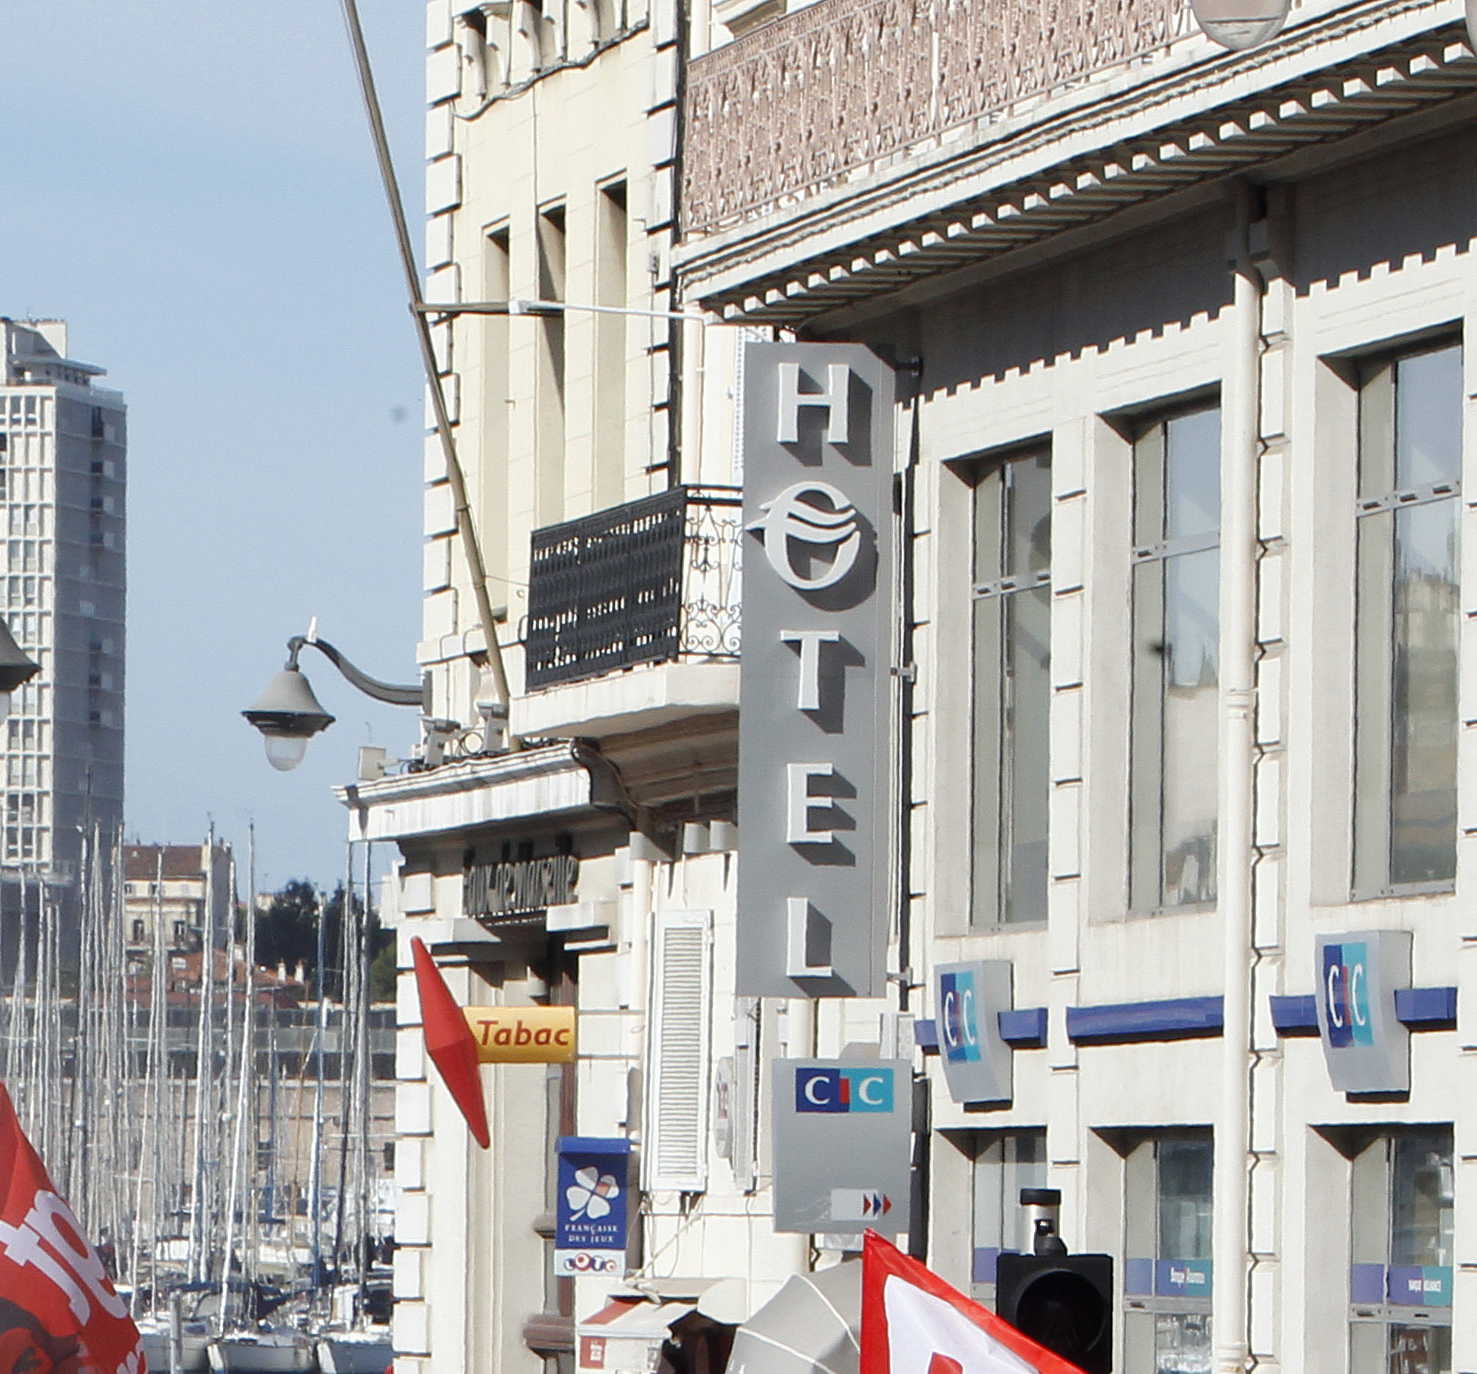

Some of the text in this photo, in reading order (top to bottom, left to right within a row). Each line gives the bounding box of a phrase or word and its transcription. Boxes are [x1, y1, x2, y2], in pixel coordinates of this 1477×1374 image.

[747, 362, 861, 977] HOTEL
[477, 1019, 571, 1047] Tabac
[804, 1076, 884, 1106] CIC
[564, 1223, 618, 1237] FRANÇAISE
[568, 1234, 614, 1244] DES JEUX
[563, 1252, 618, 1273] LOTO
